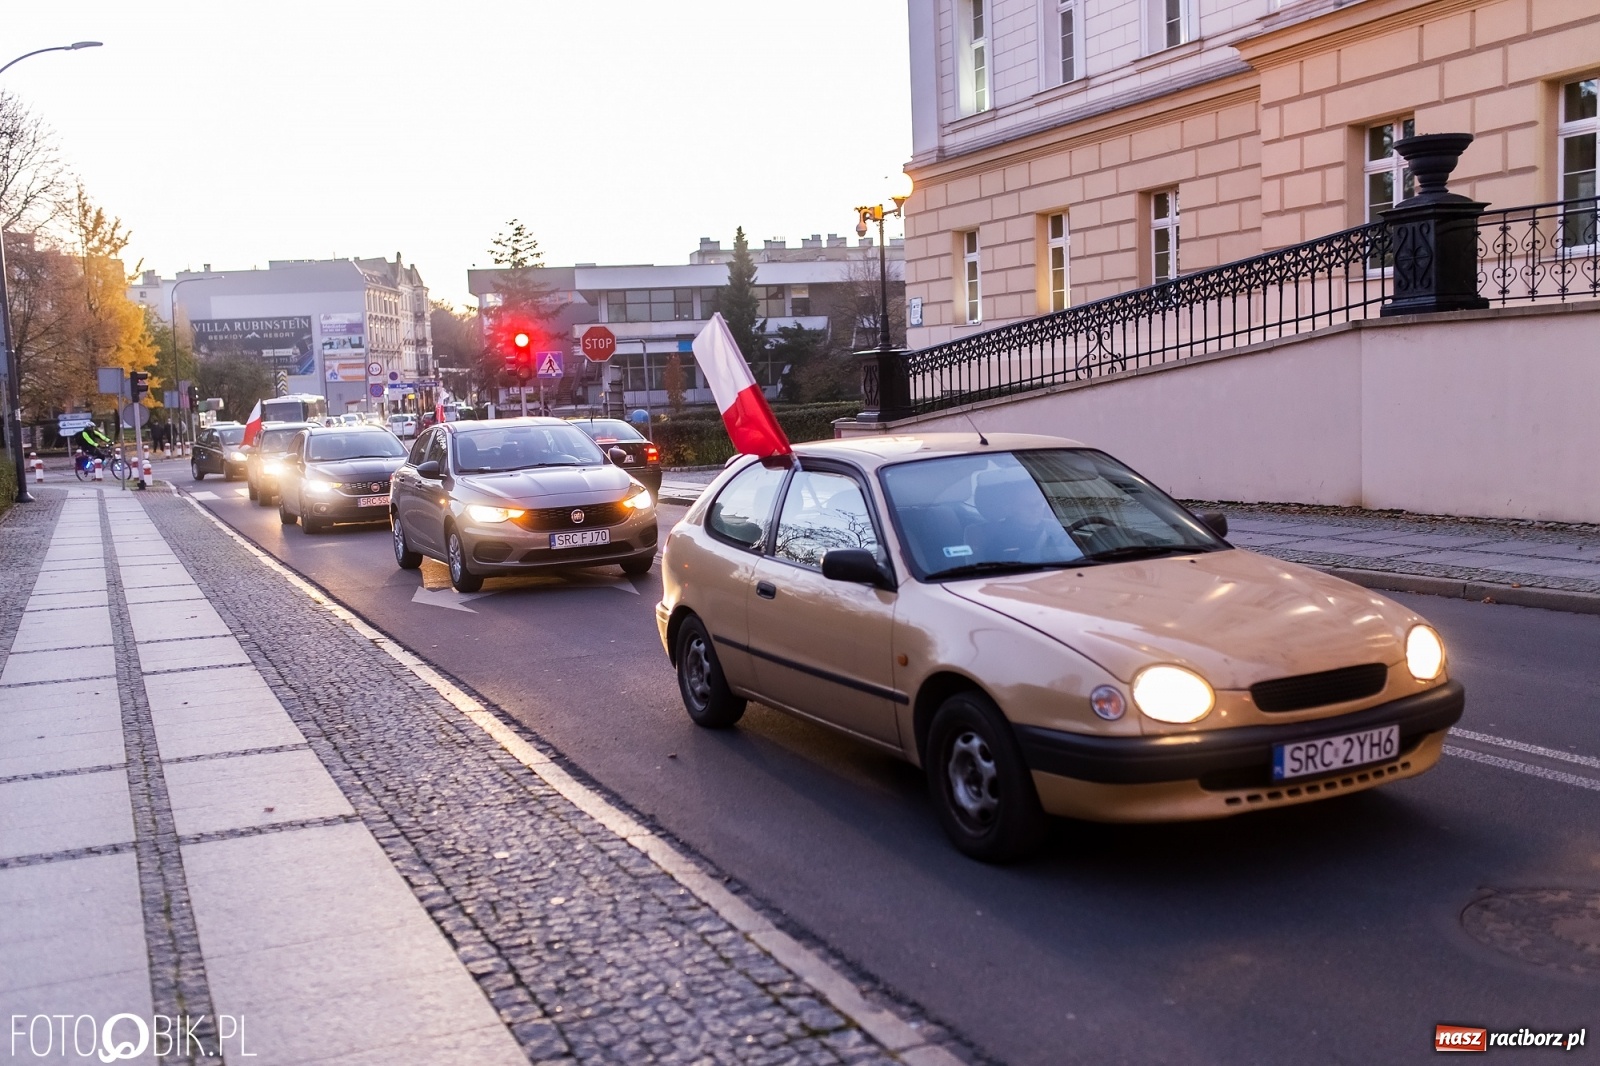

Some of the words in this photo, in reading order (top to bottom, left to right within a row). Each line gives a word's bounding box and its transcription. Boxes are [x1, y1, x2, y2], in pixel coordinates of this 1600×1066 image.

[192, 322, 231, 333] VILLA
[234, 317, 310, 332] RUBINSTEIN
[585, 338, 613, 350] STOP
[361, 497, 377, 505] SRC
[557, 534, 579, 546] SRC
[1289, 740, 1335, 774] SRC
[1341, 727, 1395, 765] 2YH6
